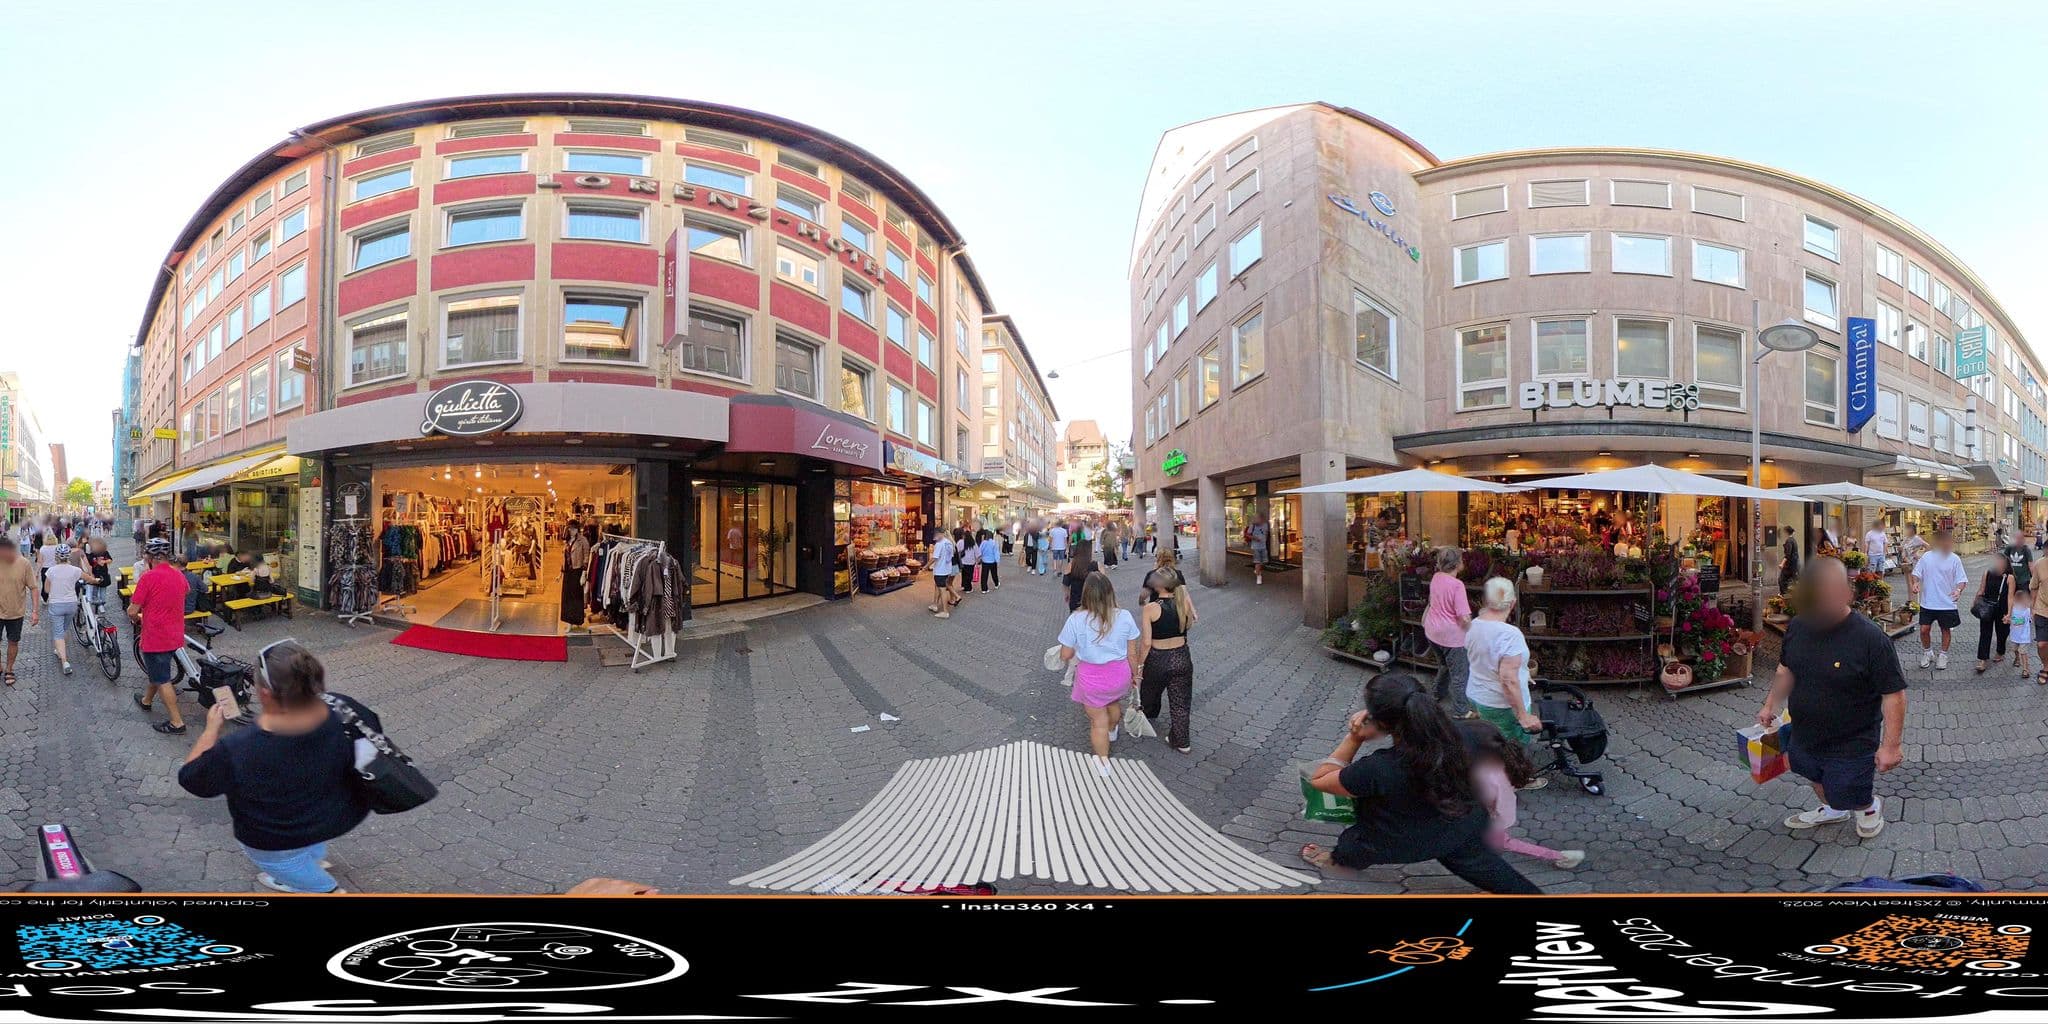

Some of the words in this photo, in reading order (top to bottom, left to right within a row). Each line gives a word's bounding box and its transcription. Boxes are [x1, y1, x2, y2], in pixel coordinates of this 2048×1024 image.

[537, 173, 888, 284] LORENZ-HOTEL
[1851, 323, 1872, 411] Champa!
[1956, 361, 1984, 377] FOTO
[421, 386, 507, 433] giulietta
[1519, 379, 1668, 409] BLUME
[811, 423, 869, 459] Lorenz
[1909, 423, 1926, 435] Nikon
